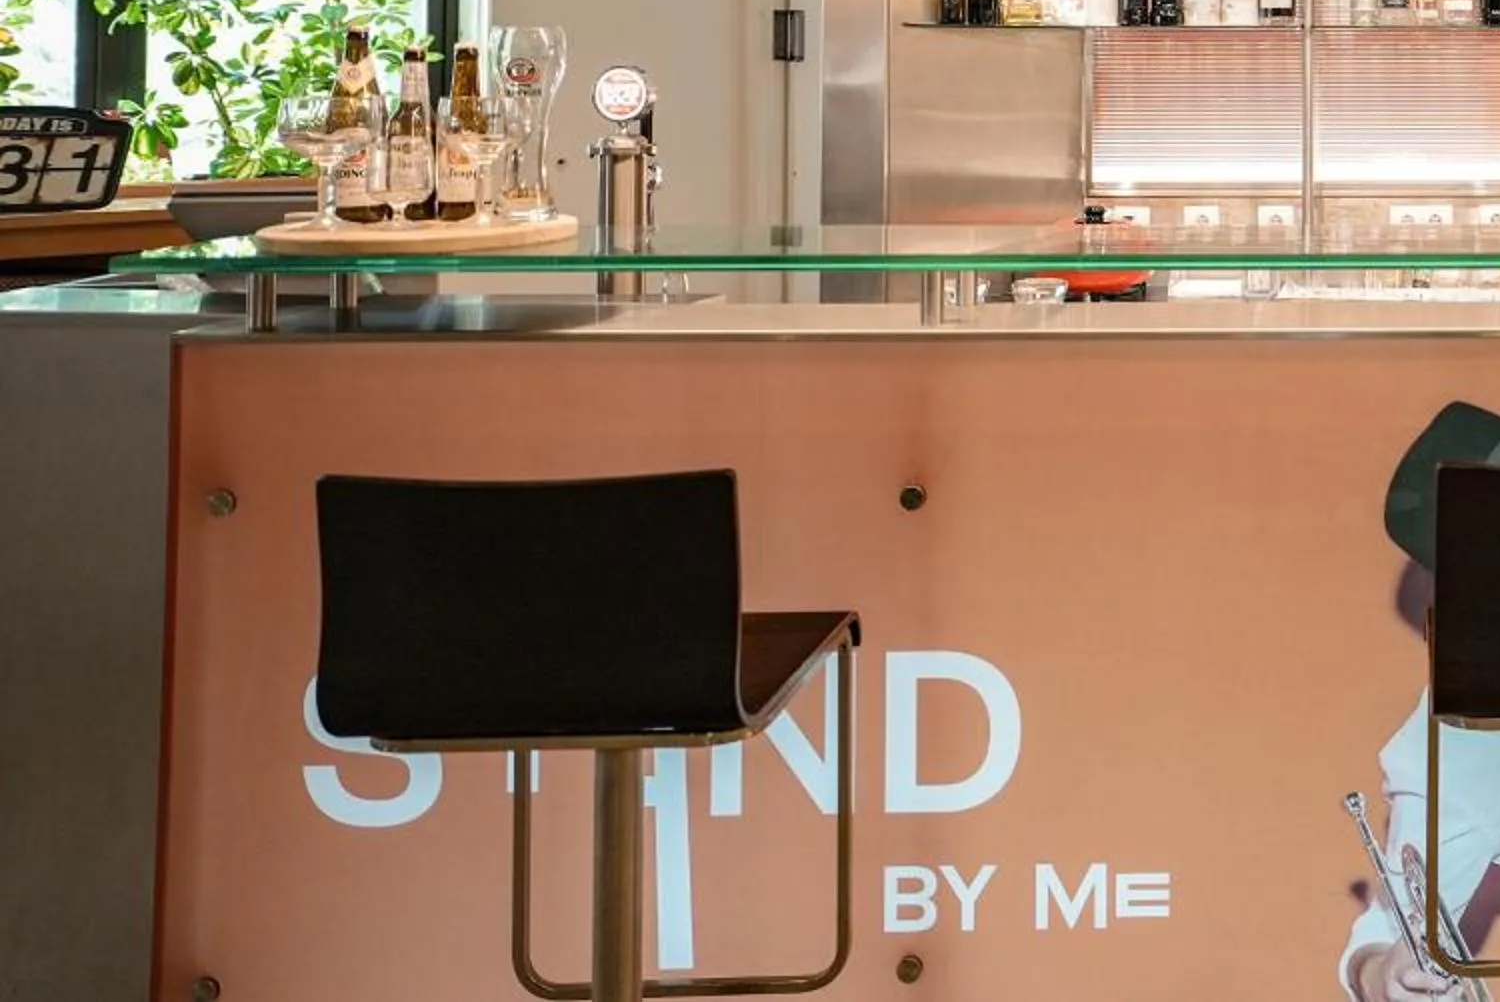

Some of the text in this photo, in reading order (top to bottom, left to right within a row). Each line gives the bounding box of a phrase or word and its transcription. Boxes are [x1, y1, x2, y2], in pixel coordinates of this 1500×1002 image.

[0, 116, 73, 132] DAY IS
[883, 863, 1171, 933] BY ME
